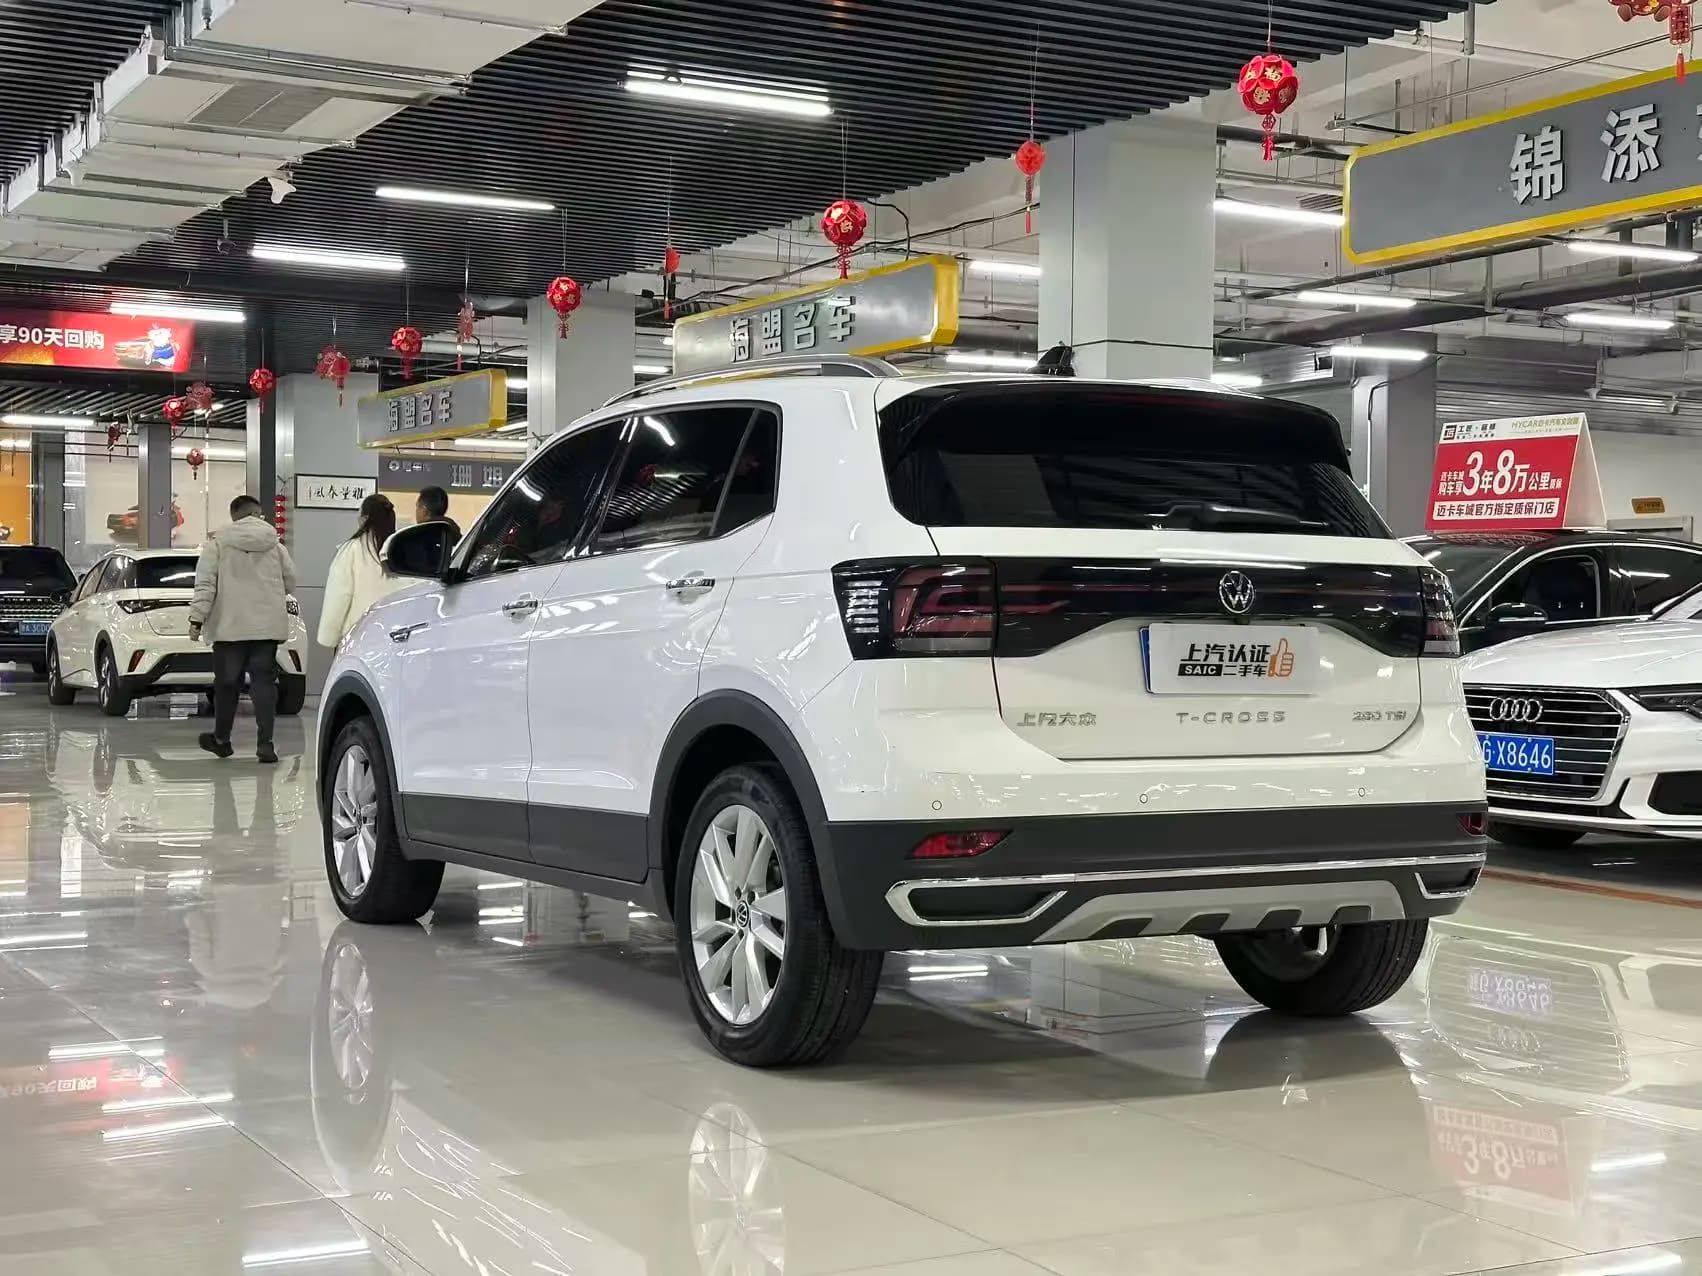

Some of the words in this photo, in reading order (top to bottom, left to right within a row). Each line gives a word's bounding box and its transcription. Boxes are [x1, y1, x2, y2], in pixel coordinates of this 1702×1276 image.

[1509, 103, 1702, 205] 锦添
[0, 324, 104, 350] 享90天回购
[1437, 501, 1556, 517] 迈卡车城官方指定质保门店
[1180, 643, 1271, 663] 上汽认证
[1184, 665, 1217, 675] SAIC
[1223, 665, 1267, 677] 二手车
[1176, 711, 1285, 724] T-CROSS
